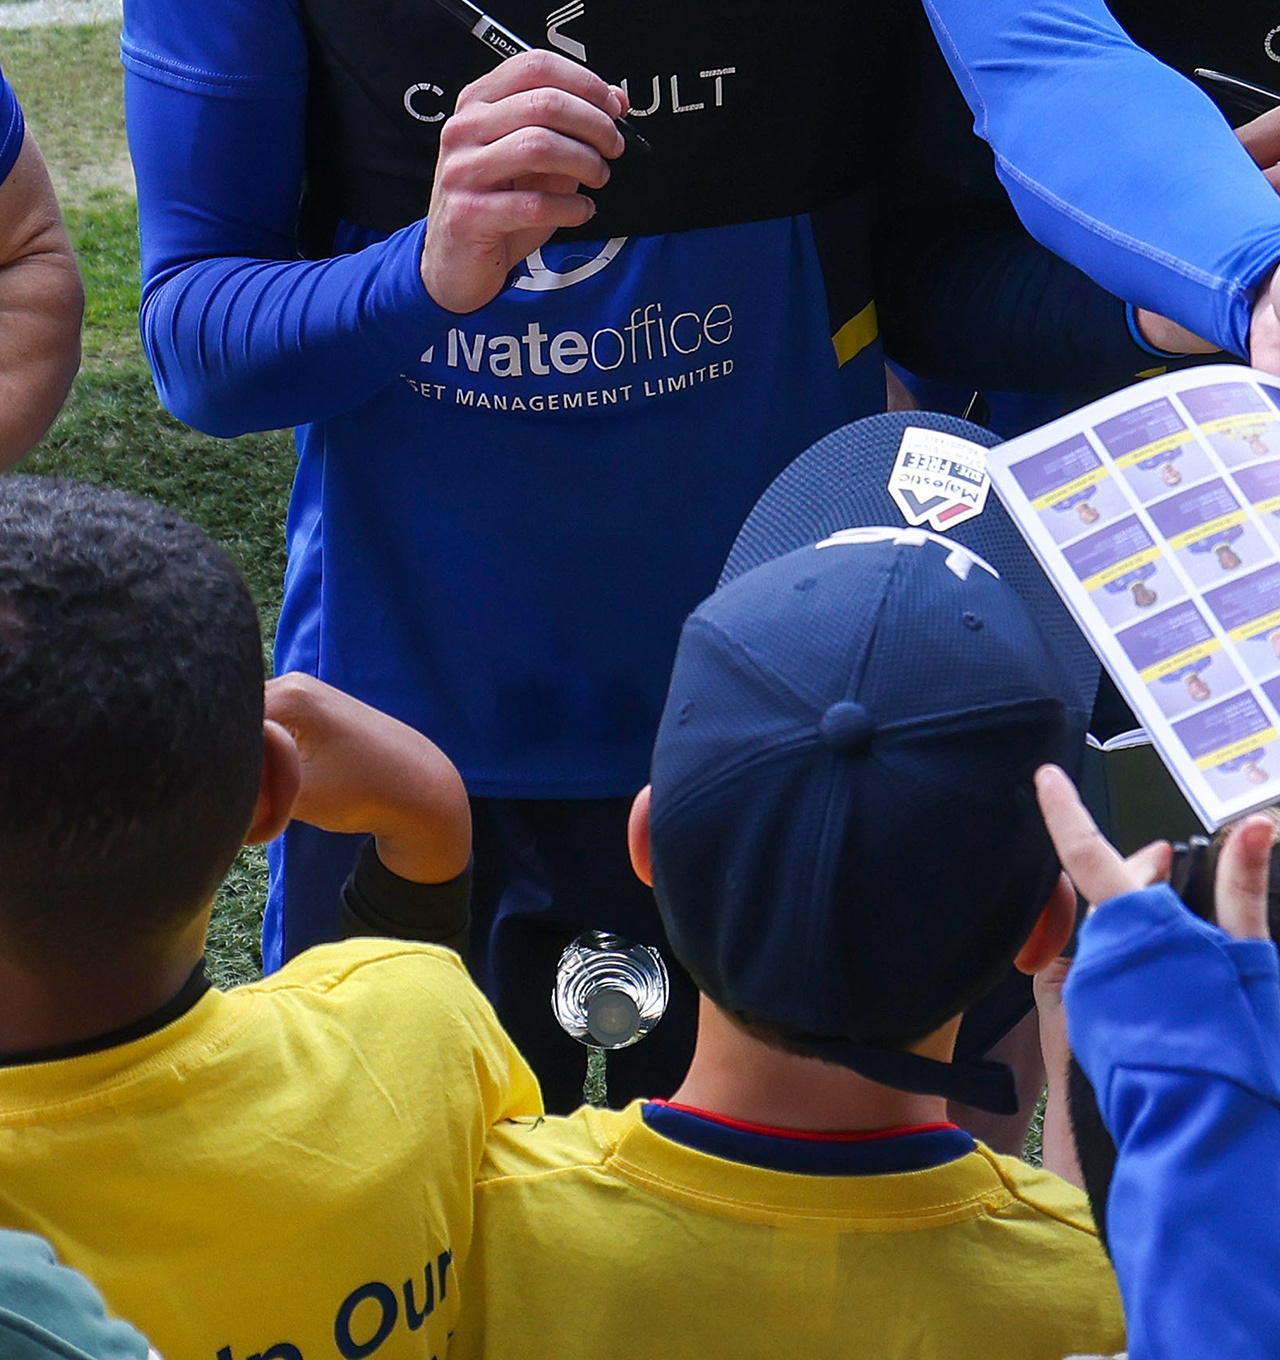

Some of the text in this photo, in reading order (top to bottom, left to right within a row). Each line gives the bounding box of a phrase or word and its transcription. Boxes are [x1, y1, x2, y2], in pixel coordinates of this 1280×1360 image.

[456, 385, 632, 412] MANAGEMENT
[645, 359, 734, 397] LIMITED
[908, 452, 952, 475] FREE
[898, 474, 979, 503] Majestic
